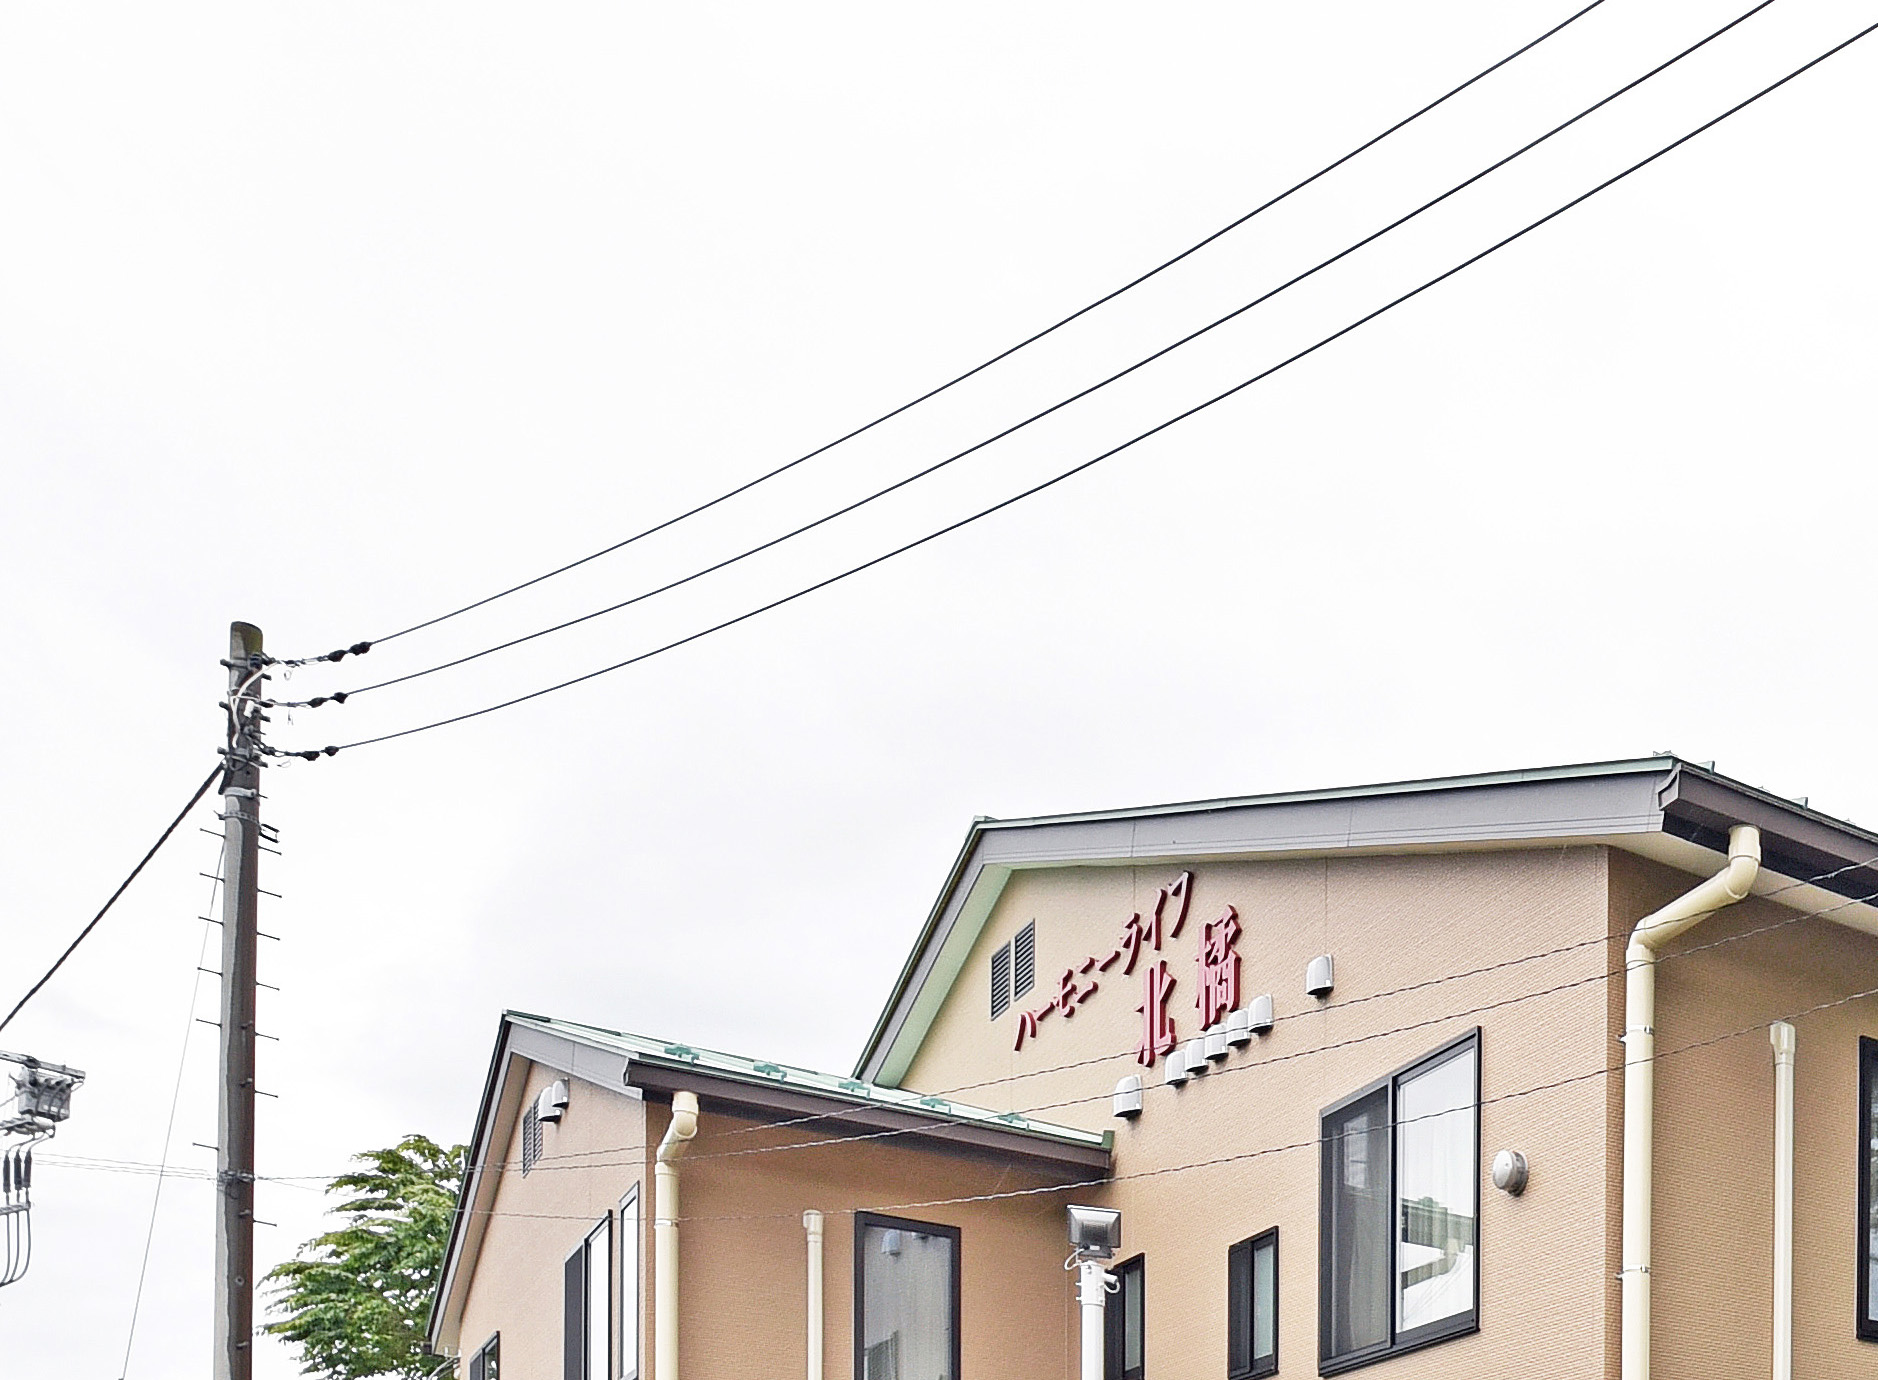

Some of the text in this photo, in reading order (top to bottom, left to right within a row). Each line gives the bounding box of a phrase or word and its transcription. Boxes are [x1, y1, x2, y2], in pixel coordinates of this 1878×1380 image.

[1014, 870, 1194, 1052] ハーモニーライフ
